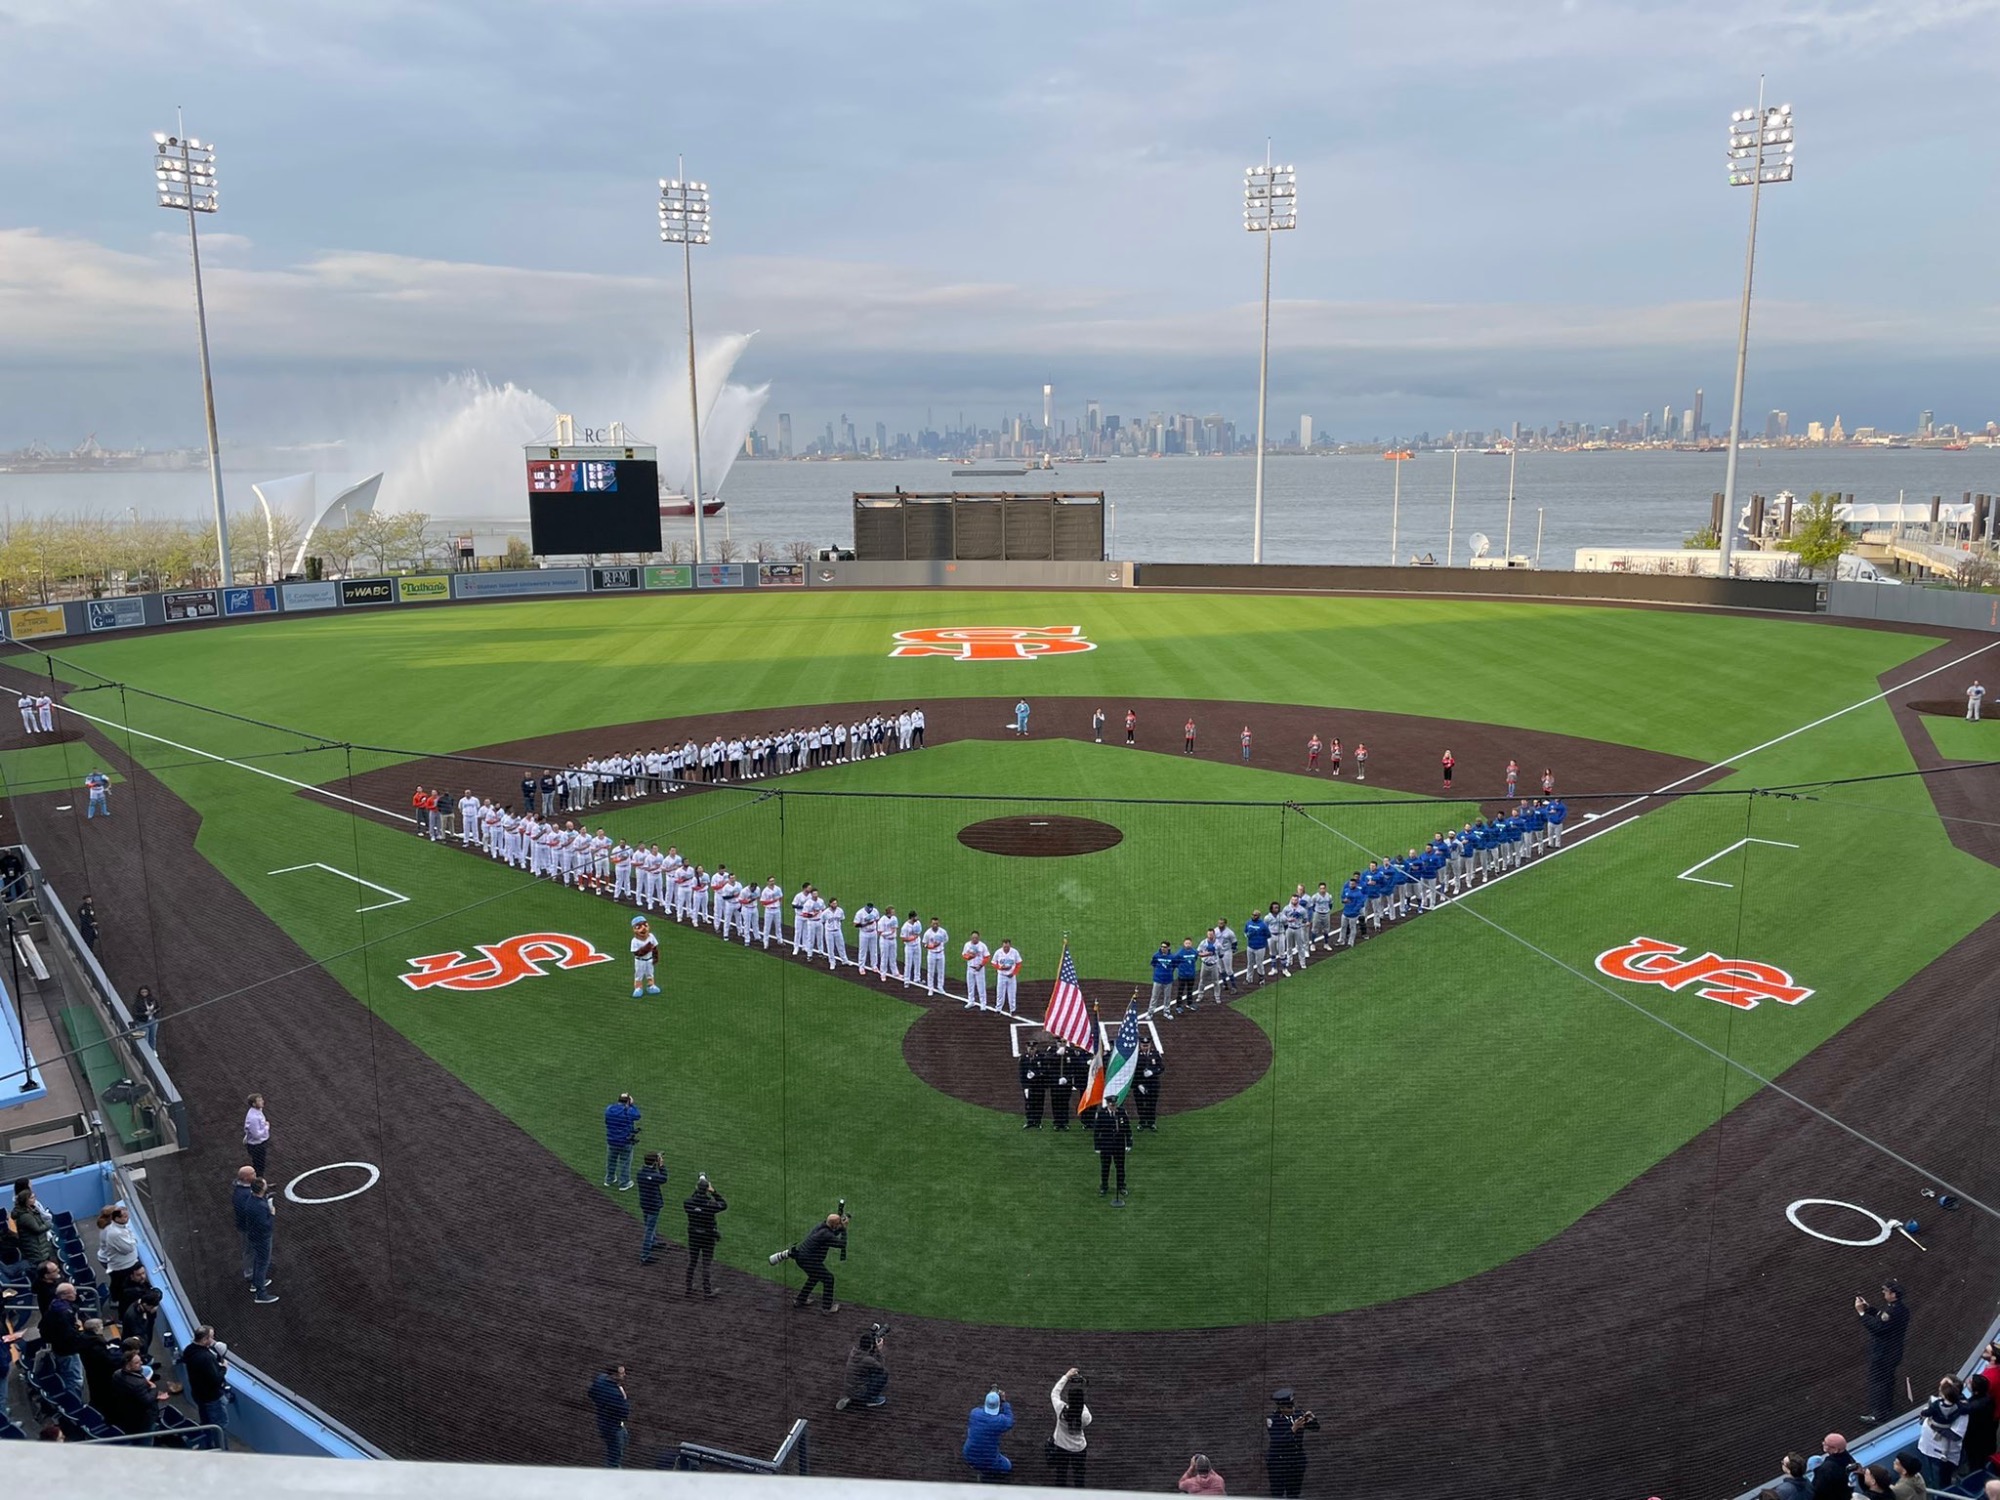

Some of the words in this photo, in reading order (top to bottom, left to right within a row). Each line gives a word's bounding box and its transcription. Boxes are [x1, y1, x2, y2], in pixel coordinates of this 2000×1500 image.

[603, 570, 630, 583] RPM
[354, 586, 390, 597] WABC
[92, 605, 101, 615] A
[103, 603, 113, 614] &
[93, 617, 103, 627] G
